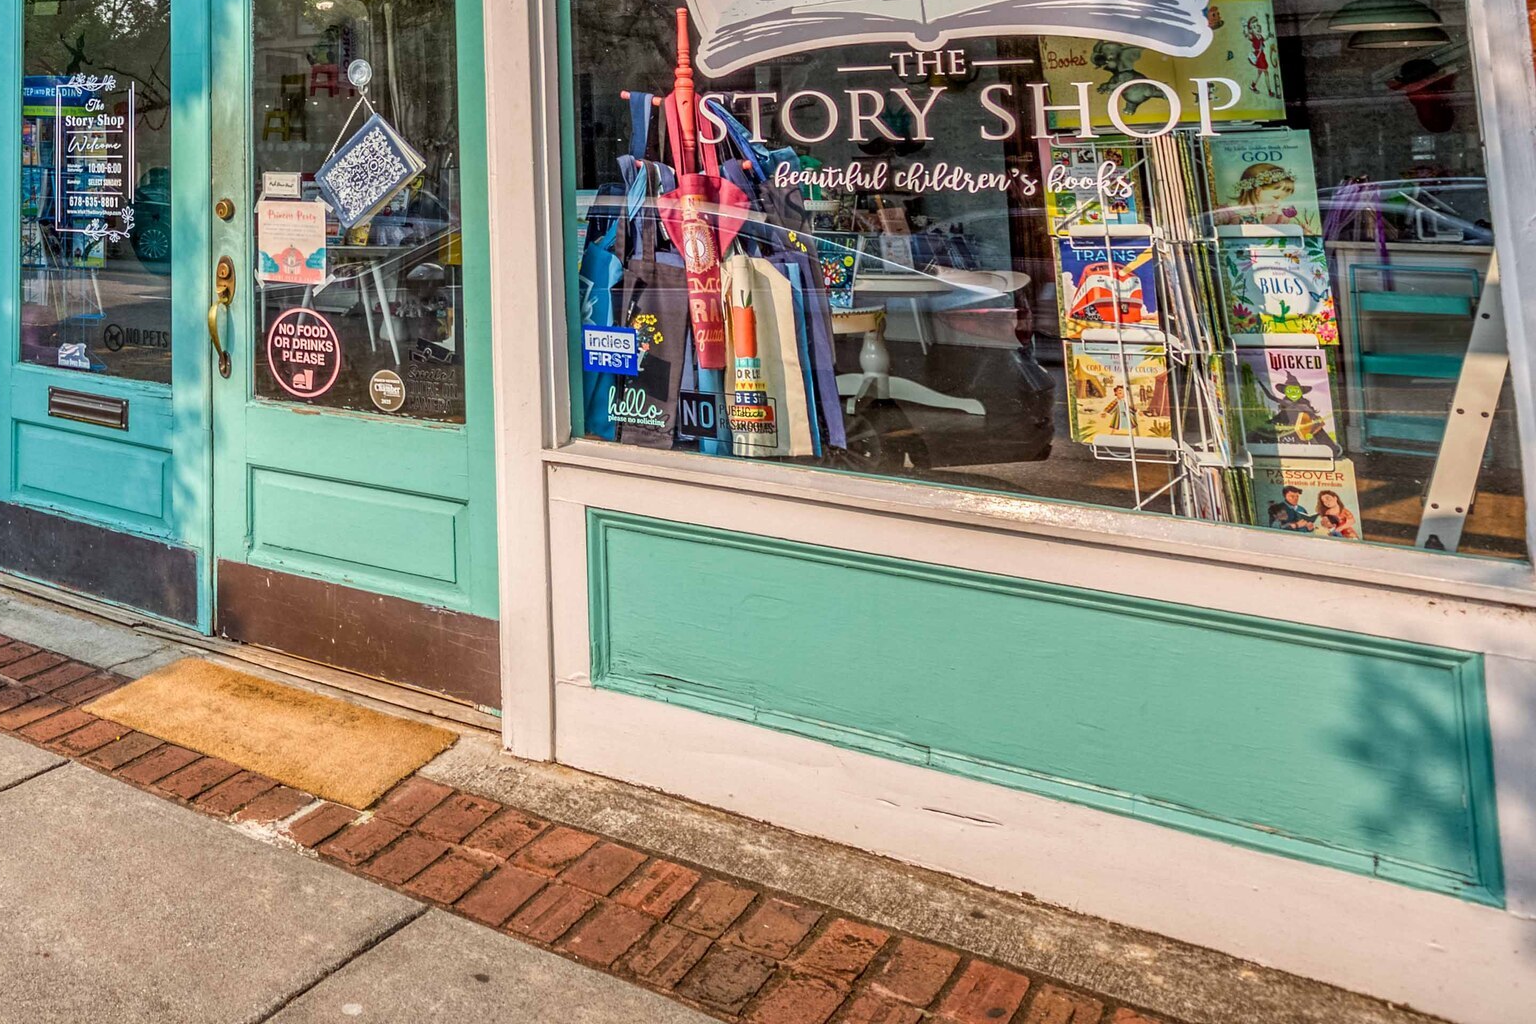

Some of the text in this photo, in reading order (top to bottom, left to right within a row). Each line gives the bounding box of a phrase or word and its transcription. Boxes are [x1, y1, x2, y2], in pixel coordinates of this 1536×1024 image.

[889, 50, 967, 76] THE
[1048, 50, 1087, 71] Books
[85, 98, 105, 112] The
[698, 77, 1242, 144] STORY SHOP
[65, 114, 124, 129] Story Shop
[67, 136, 122, 153] Welcome
[1241, 150, 1283, 163] GOD
[88, 163, 122, 174] 10:00-6:00
[774, 161, 887, 192] beautiful
[894, 162, 1038, 195] children's
[1046, 160, 1135, 198] books
[1072, 249, 1137, 262] TRANS
[1260, 277, 1303, 296] BUGS
[126, 327, 169, 348] NO PETS
[278, 323, 328, 338] NO FOOD
[274, 335, 334, 353] OR DRINKS
[589, 333, 631, 350] indies
[282, 350, 326, 366] PLEASE
[588, 351, 632, 369] FIRST
[1268, 351, 1323, 371] WICKED
[607, 385, 663, 418] hello
[608, 415, 627, 423] please
[637, 417, 666, 428] soliciting
[682, 399, 714, 429] NO
[1266, 469, 1344, 481] PASSOVER
